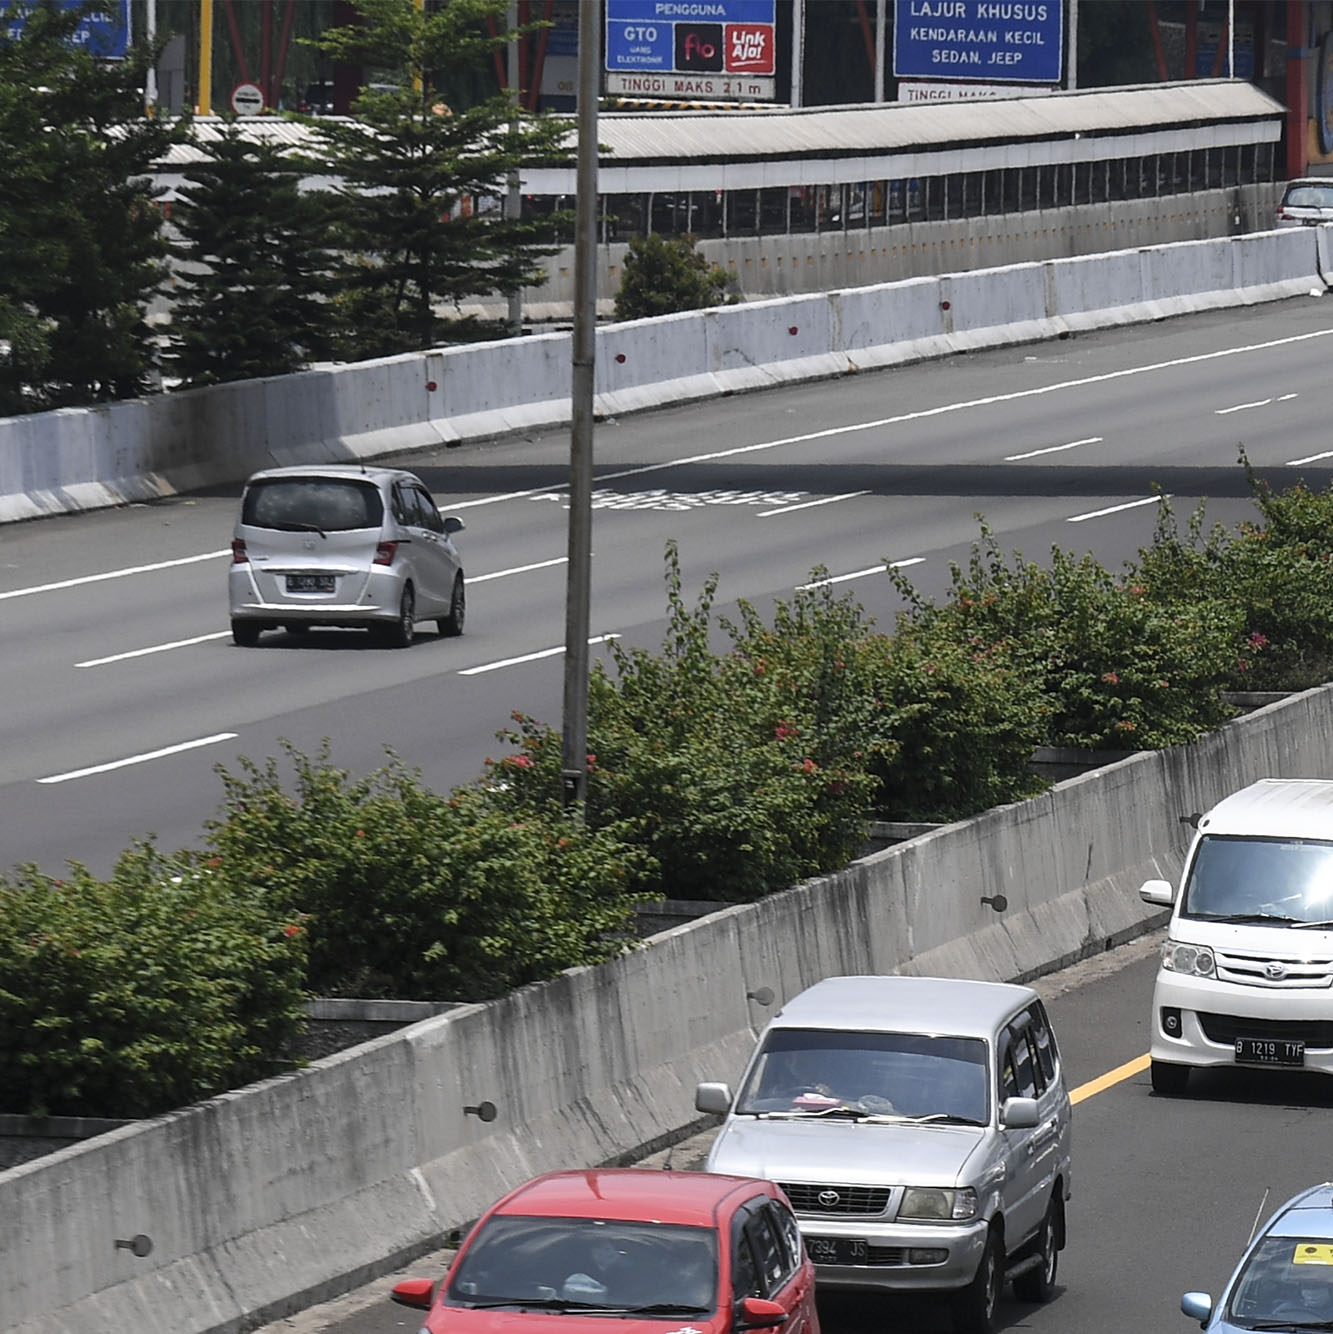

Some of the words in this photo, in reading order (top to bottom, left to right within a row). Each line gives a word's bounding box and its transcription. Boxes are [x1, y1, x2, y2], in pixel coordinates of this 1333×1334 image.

[655, 3, 726, 16] PENGGUNA
[910, 1, 966, 18] LAJUR
[977, 4, 1048, 21] KHUSUS
[624, 27, 657, 42] GTO
[732, 31, 765, 47] Link
[910, 28, 998, 43] KENDARAAN
[1004, 31, 1045, 45] KECIL
[617, 55, 663, 64] ELEKTRONIK
[932, 50, 982, 65] SEDAN,
[987, 52, 1023, 65] JEEP
[621, 78, 667, 92] TINGGI
[674, 81, 713, 93] MAKS
[748, 85, 761, 94] m
[1236, 1041, 1243, 1053] B
[1252, 1042, 1276, 1055] 1219
